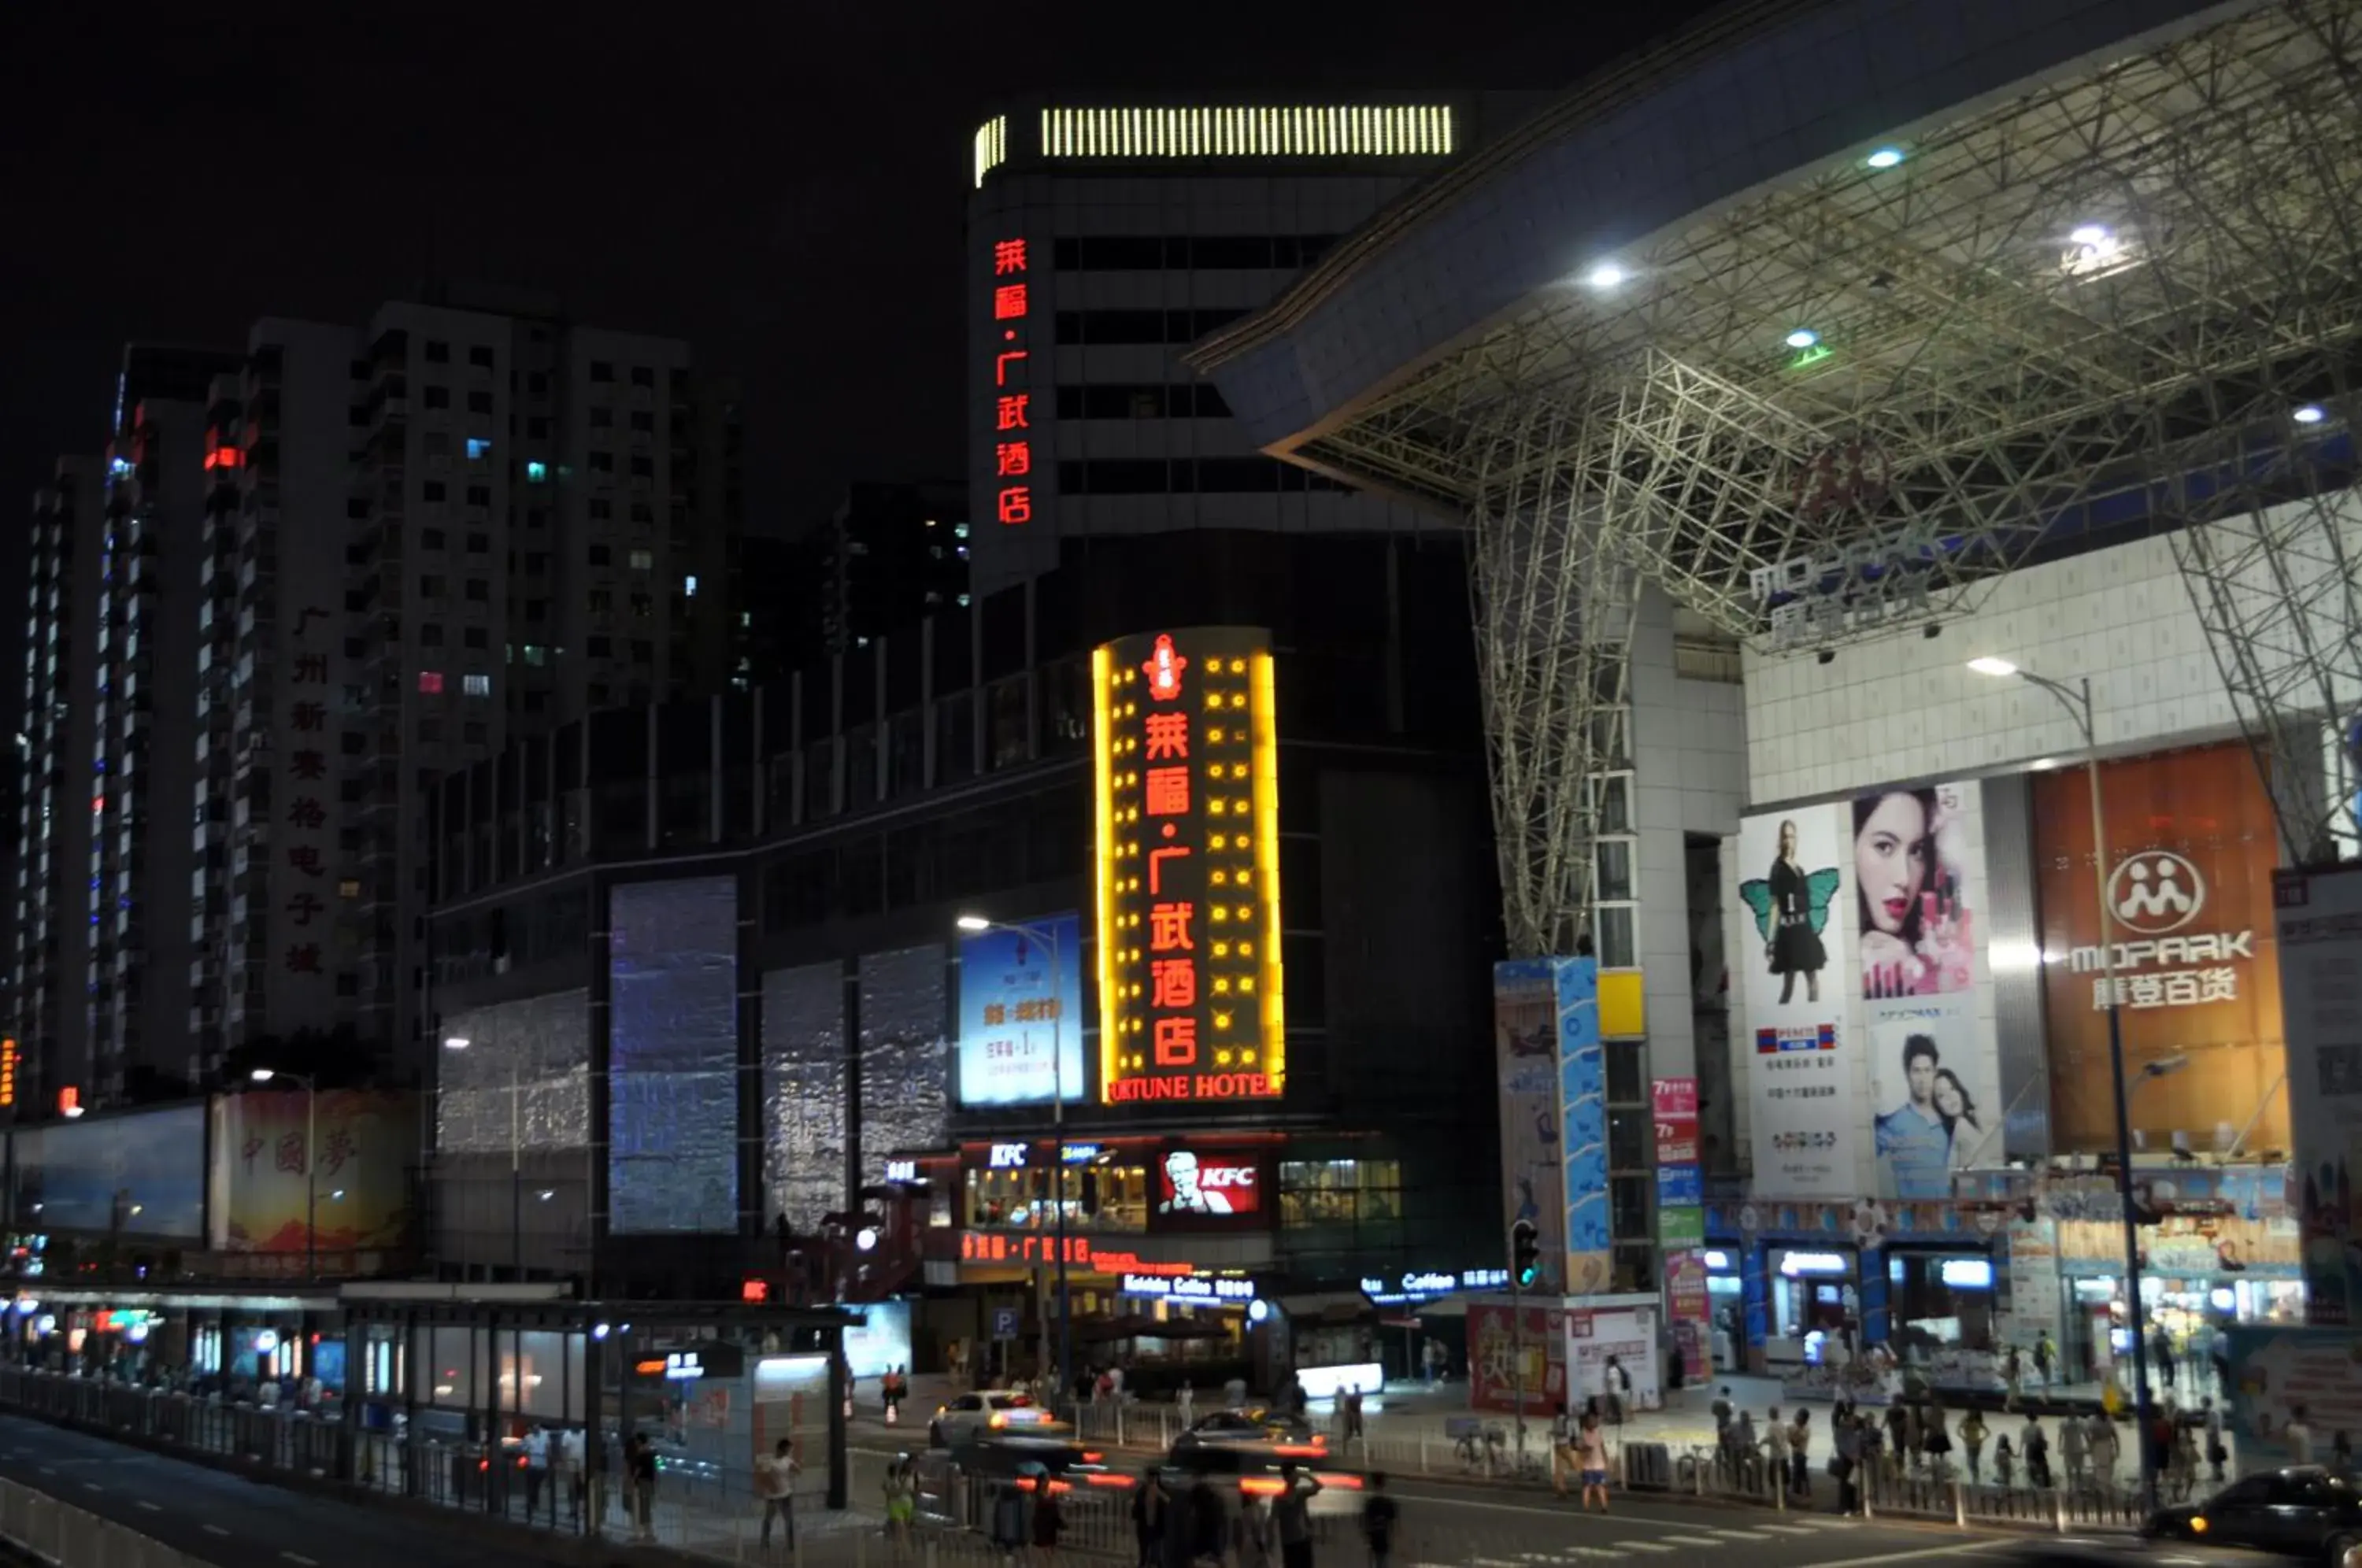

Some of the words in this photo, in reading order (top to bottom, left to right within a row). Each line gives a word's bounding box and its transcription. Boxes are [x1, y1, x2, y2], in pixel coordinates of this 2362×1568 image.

[994, 238, 1032, 525] 莱福·广武酒店
[287, 605, 331, 975] 广州新赛格电子城
[1145, 711, 1198, 1067] 莱福·广武酒店
[2092, 966, 2238, 1011] 摩登百货
[241, 1127, 359, 1177] 中國夢
[990, 1143, 1027, 1167] KFC
[1201, 1167, 1257, 1187] KFC
